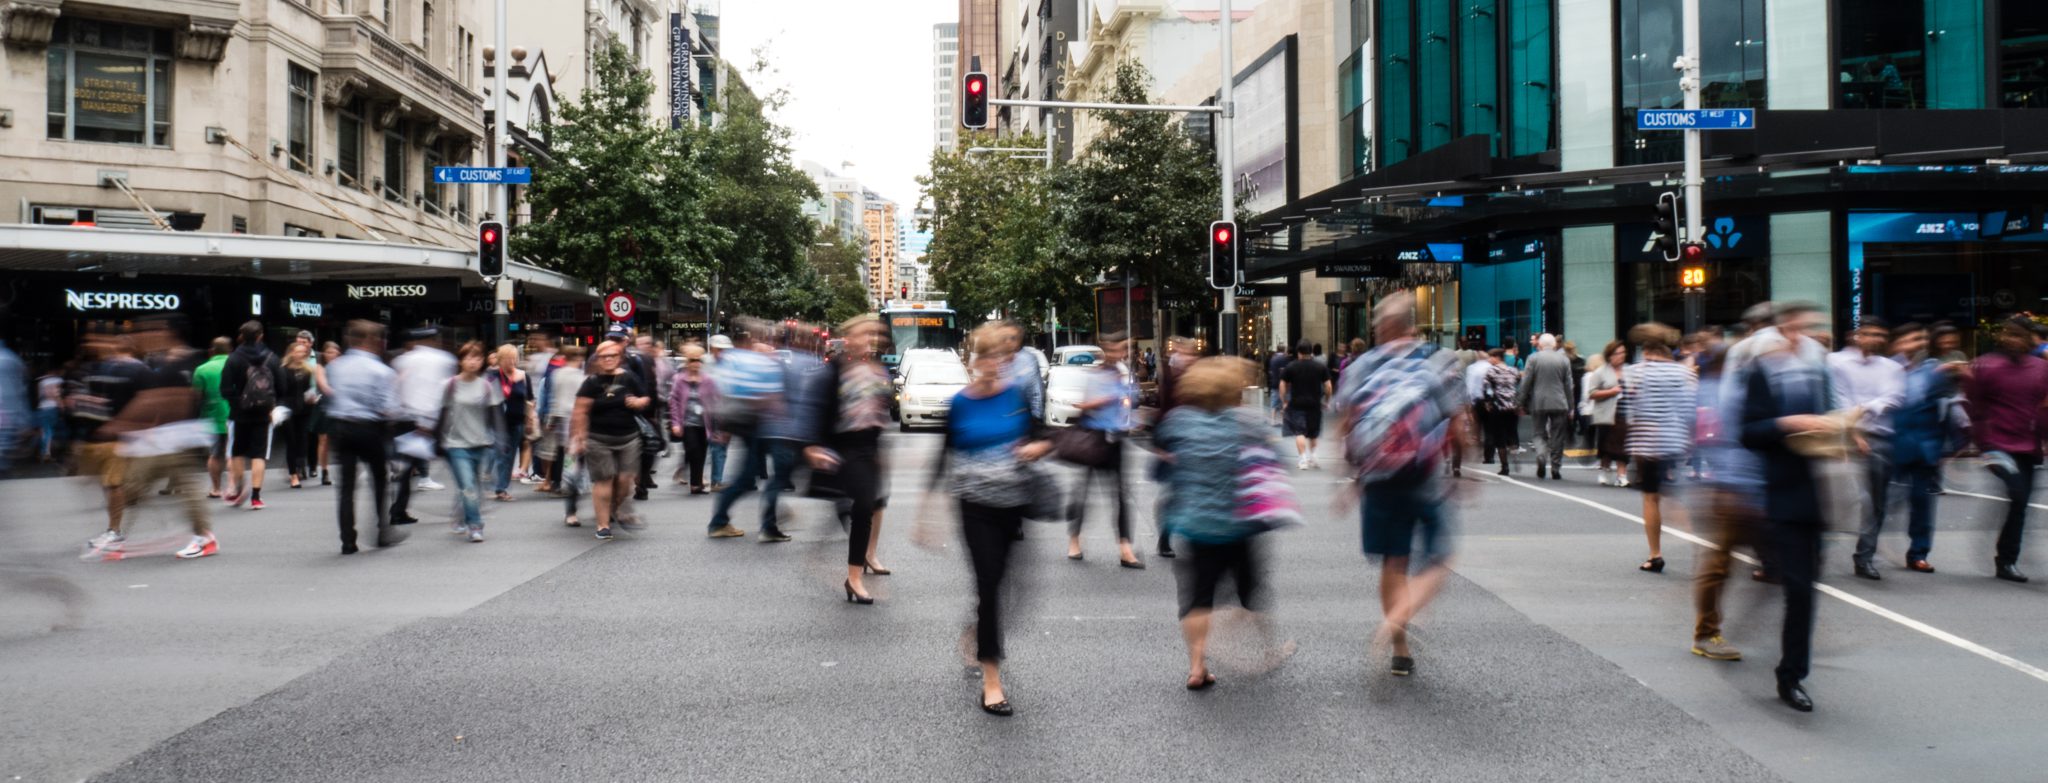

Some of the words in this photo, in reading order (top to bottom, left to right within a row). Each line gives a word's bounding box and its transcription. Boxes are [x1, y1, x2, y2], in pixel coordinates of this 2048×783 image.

[672, 26, 681, 64] GRAND
[681, 41, 689, 78] GRAND
[84, 78, 113, 88] STRATA
[115, 80, 137, 91] TITLE
[672, 67, 681, 117] WINDSOR
[74, 88, 97, 98] BODY
[98, 91, 146, 104] CORPORATE
[681, 80, 689, 122] WINDSO
[82, 101, 138, 113] MANAGEMENT
[1643, 112, 1696, 126] CUSTOMS
[1700, 110, 1708, 118] ST
[1709, 110, 1725, 118] WEST
[460, 169, 502, 181] CUSTOMS
[1916, 223, 1945, 234] ANZ
[1397, 251, 1418, 260] ANZ
[1333, 264, 1371, 273] SWAROVSKI
[1683, 269, 1704, 285] 20
[64, 288, 180, 311] NESPRESSO
[346, 284, 427, 299] NESPRESSO
[289, 298, 322, 317] NESPRESSO
[613, 301, 629, 312] 30
